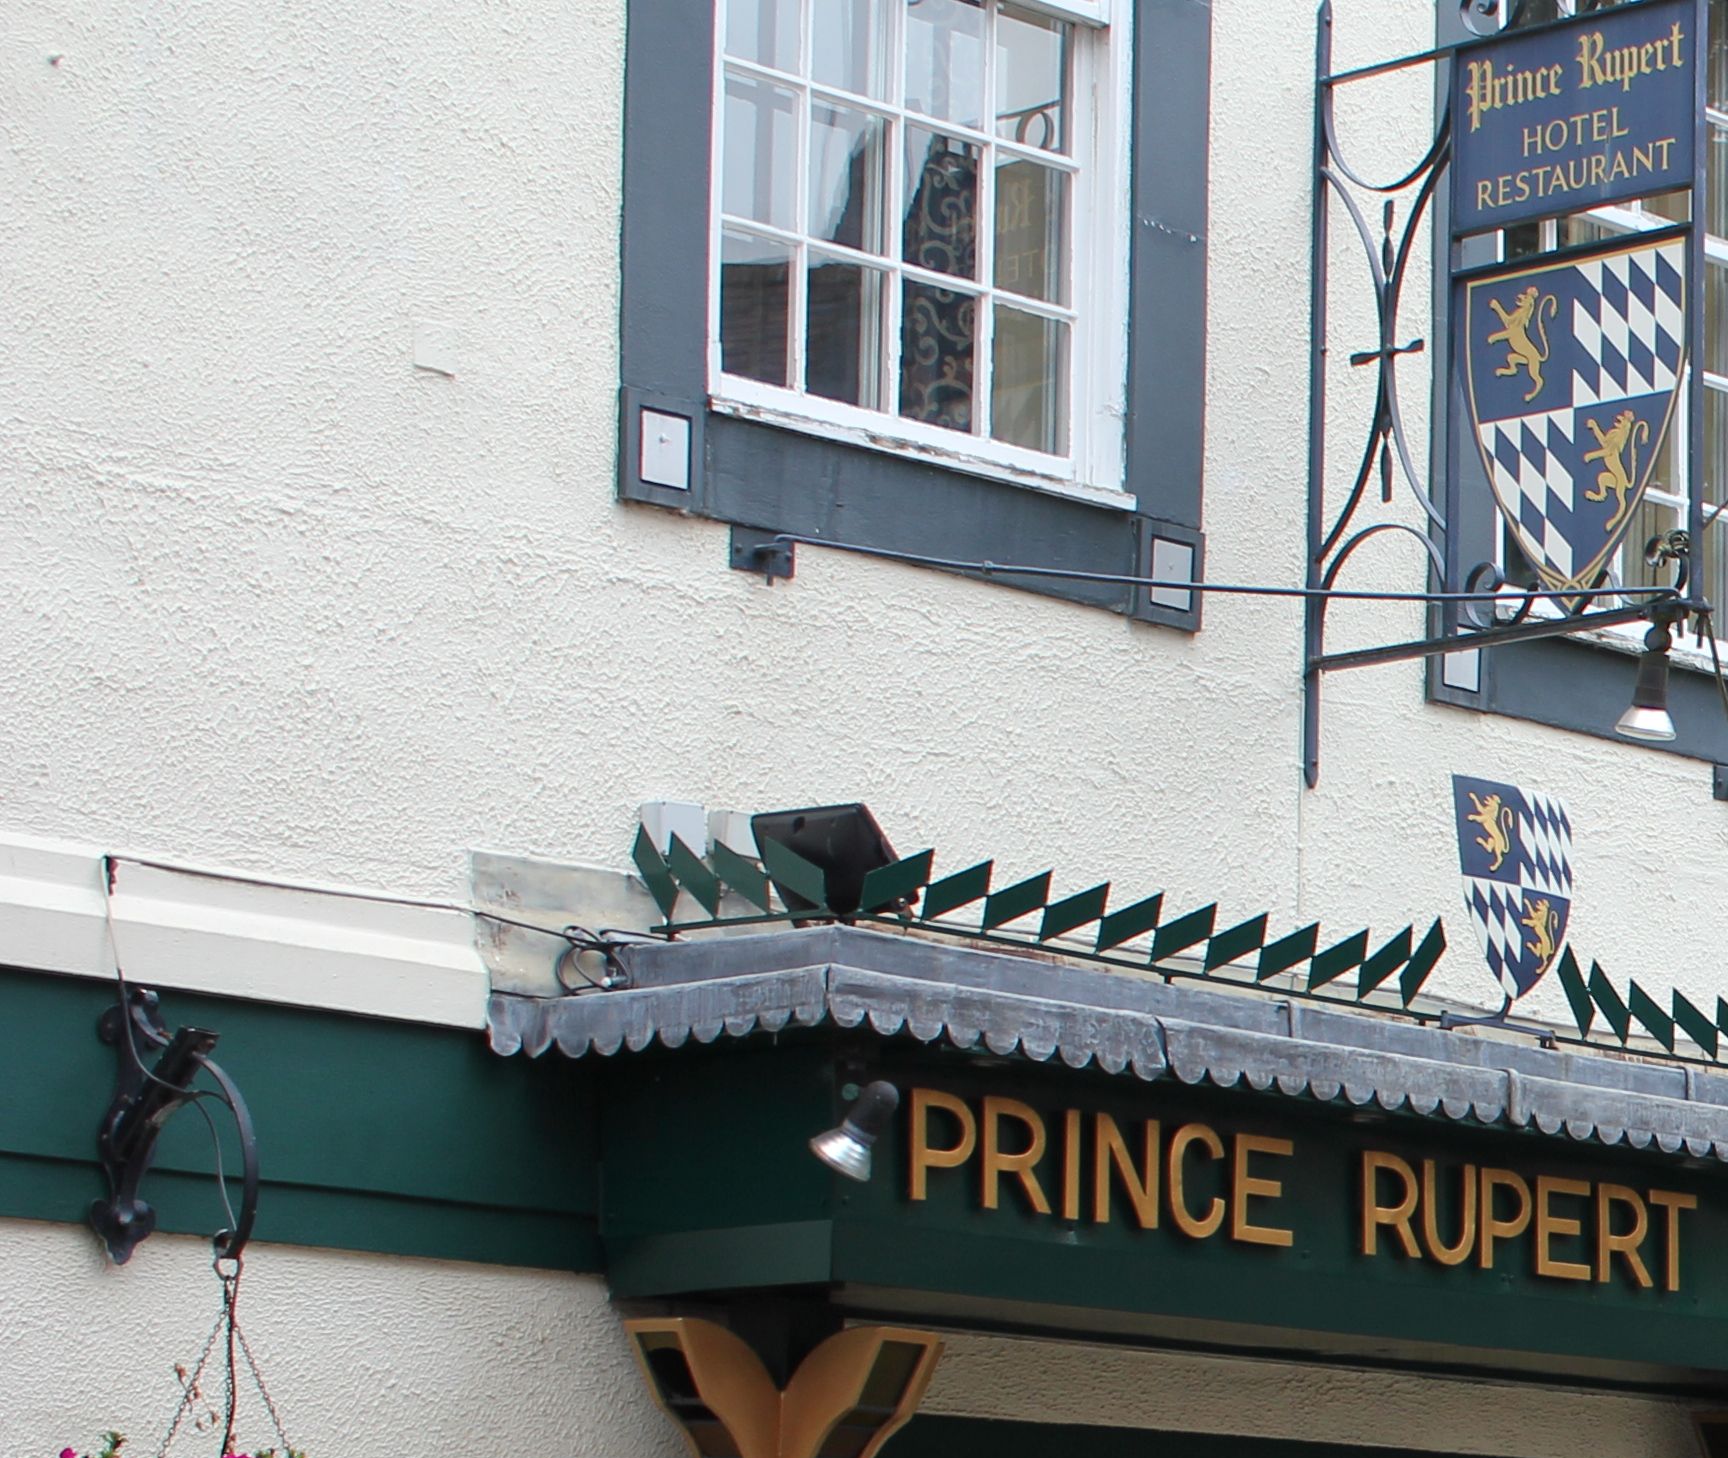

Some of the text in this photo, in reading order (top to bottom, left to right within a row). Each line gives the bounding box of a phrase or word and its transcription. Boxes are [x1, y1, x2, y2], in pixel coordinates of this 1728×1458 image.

[1465, 22, 1684, 133] Prince Rupert
[1476, 138, 1676, 210] RESTAURANT
[1522, 106, 1629, 157] HOTEL
[909, 1087, 1294, 1248] PRINCE
[1361, 1149, 1698, 1292] RUPERT
